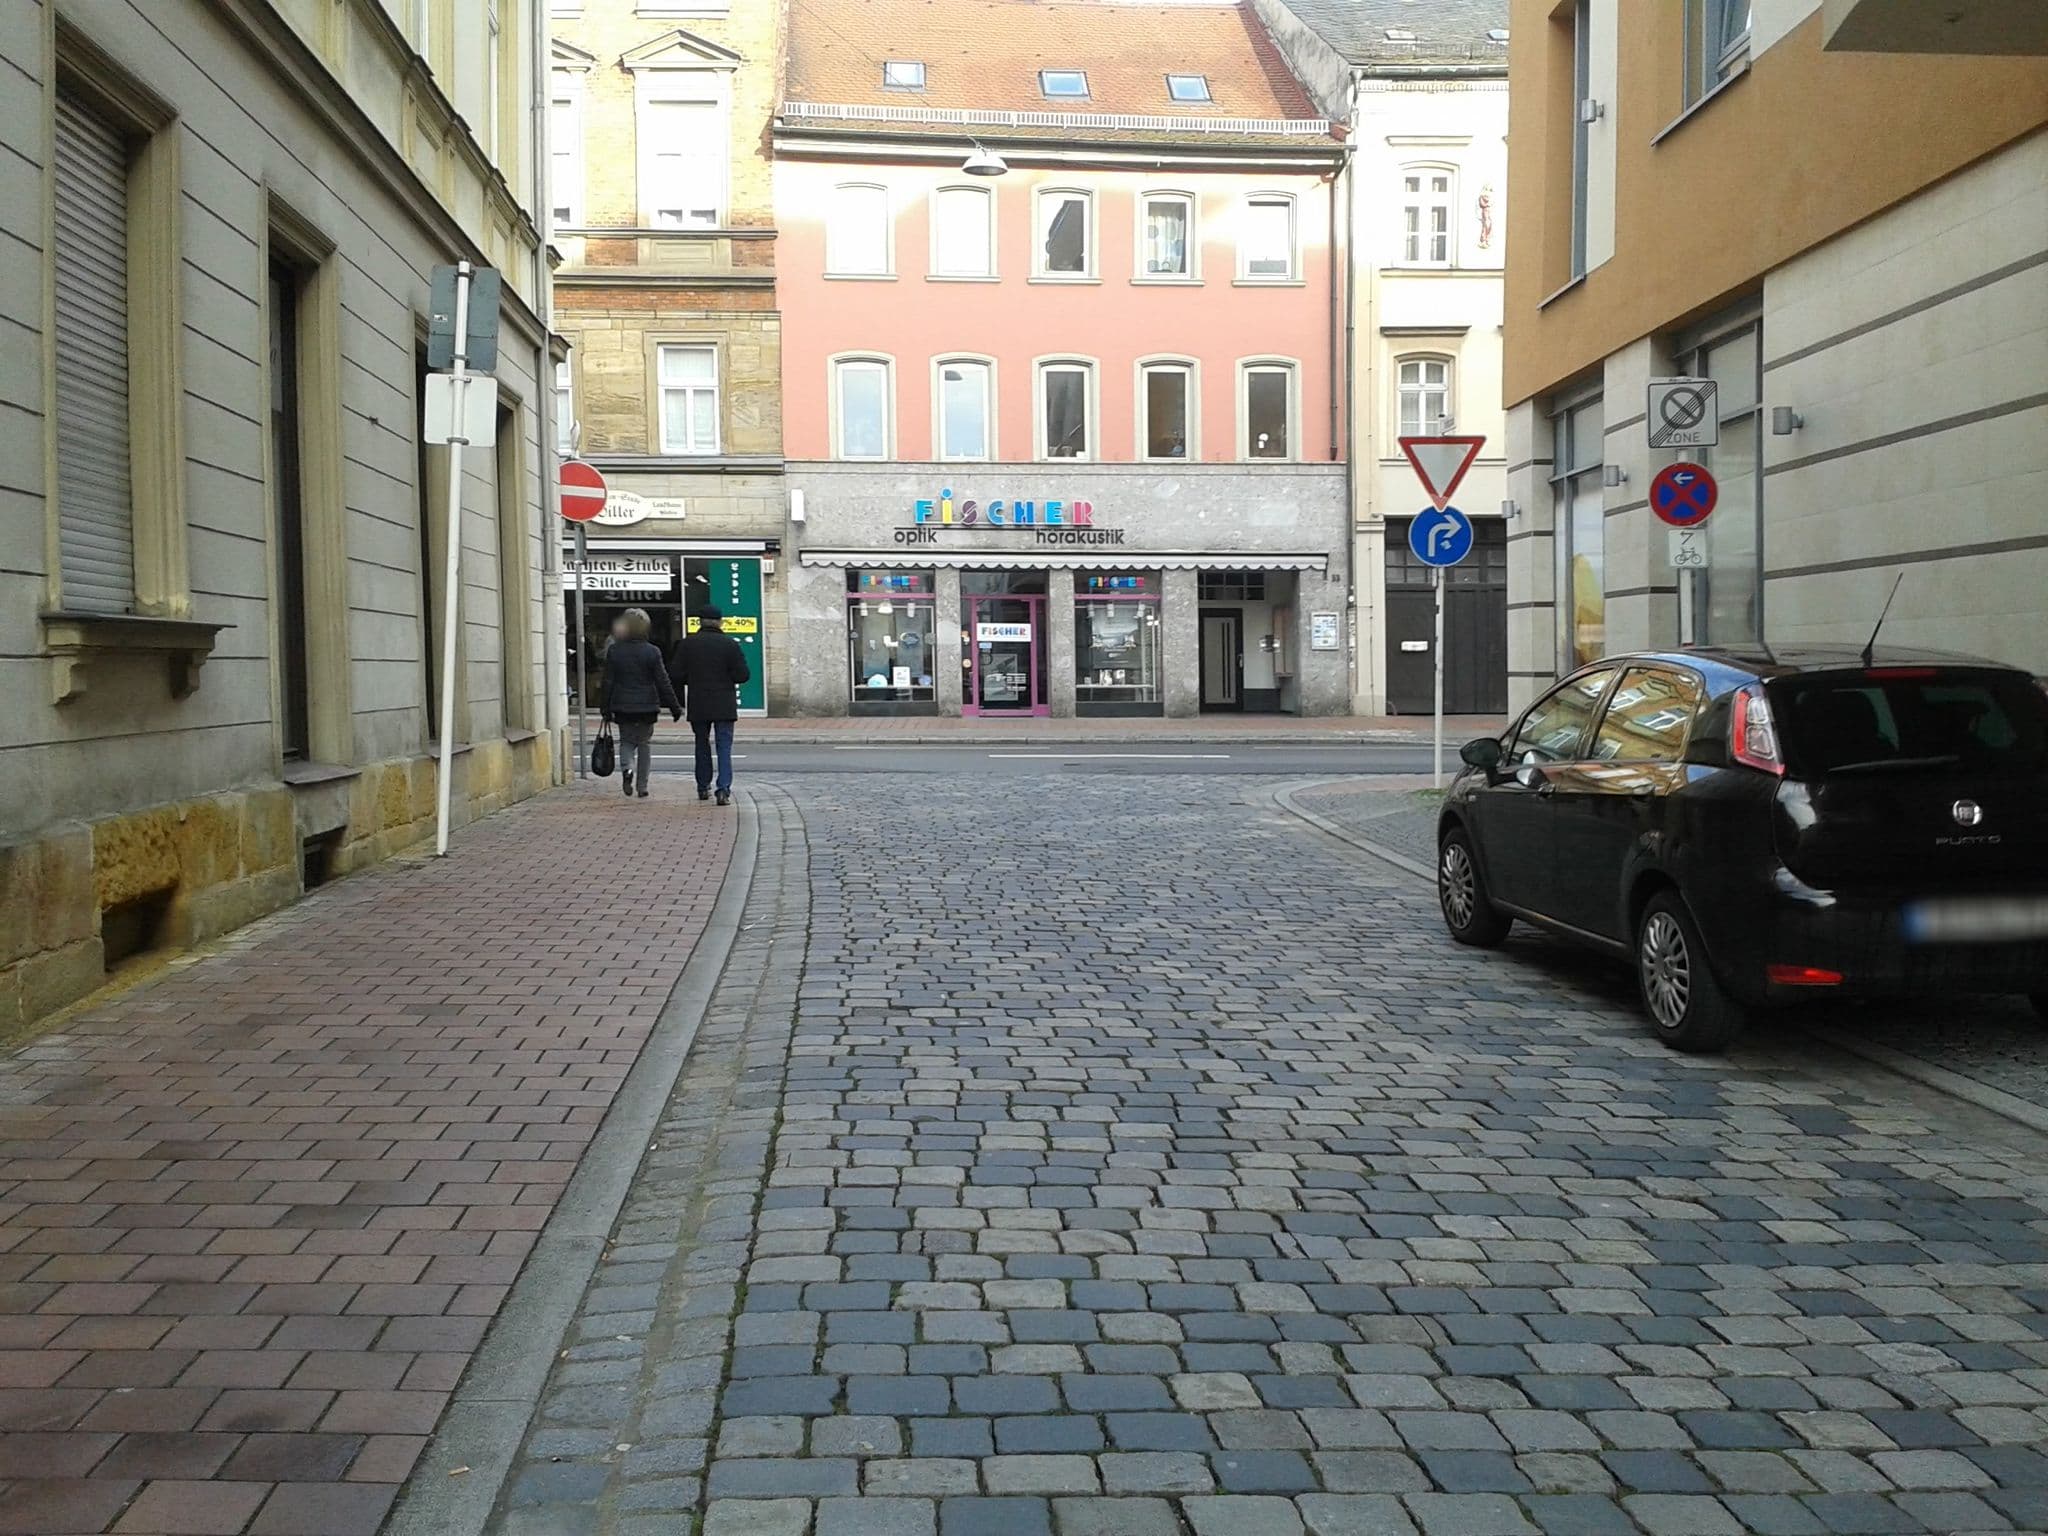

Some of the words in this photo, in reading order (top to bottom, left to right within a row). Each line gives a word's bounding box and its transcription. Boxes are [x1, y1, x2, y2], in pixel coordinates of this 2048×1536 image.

[1667, 432, 1700, 444] ZONE
[894, 527, 938, 546] optik
[585, 577, 630, 588] Diller
[981, 626, 1026, 636] FISCHER
